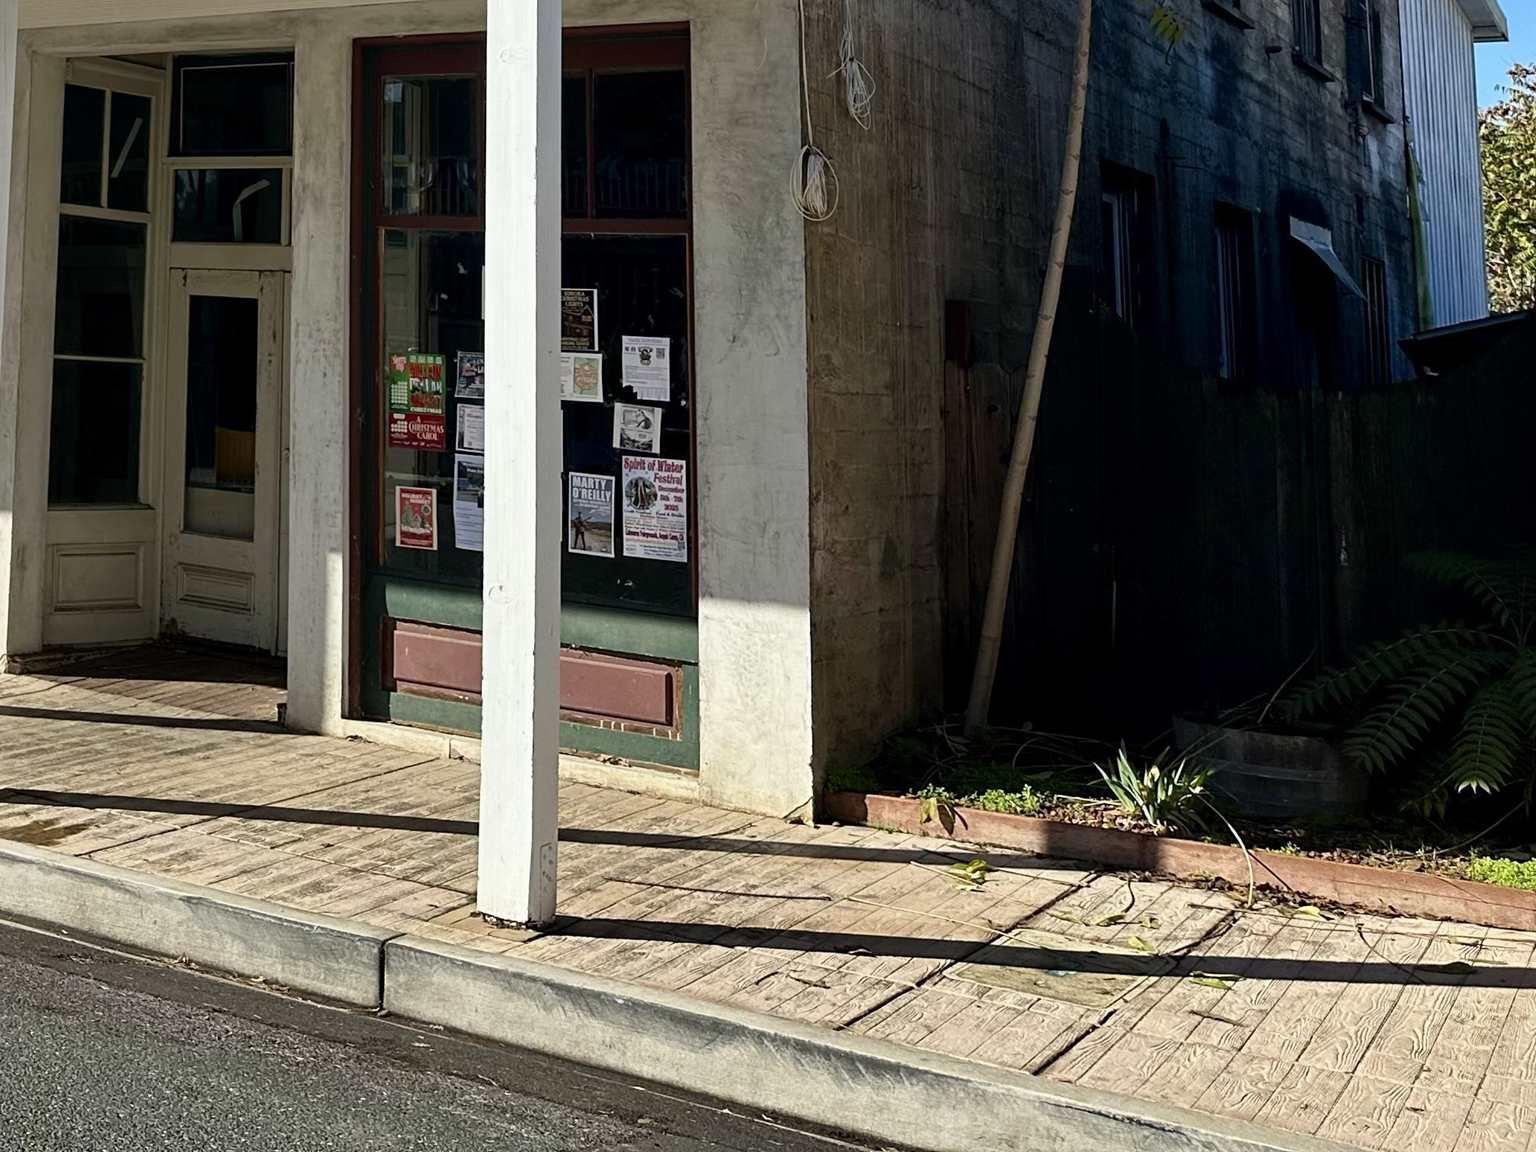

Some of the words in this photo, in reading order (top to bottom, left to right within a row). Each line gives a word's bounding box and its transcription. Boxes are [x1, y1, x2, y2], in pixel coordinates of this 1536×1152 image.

[624, 458, 646, 472] Spirit
[648, 460, 656, 471] of
[657, 460, 684, 474] Winter
[572, 476, 607, 490] MARTY
[653, 472, 683, 486] Festival
